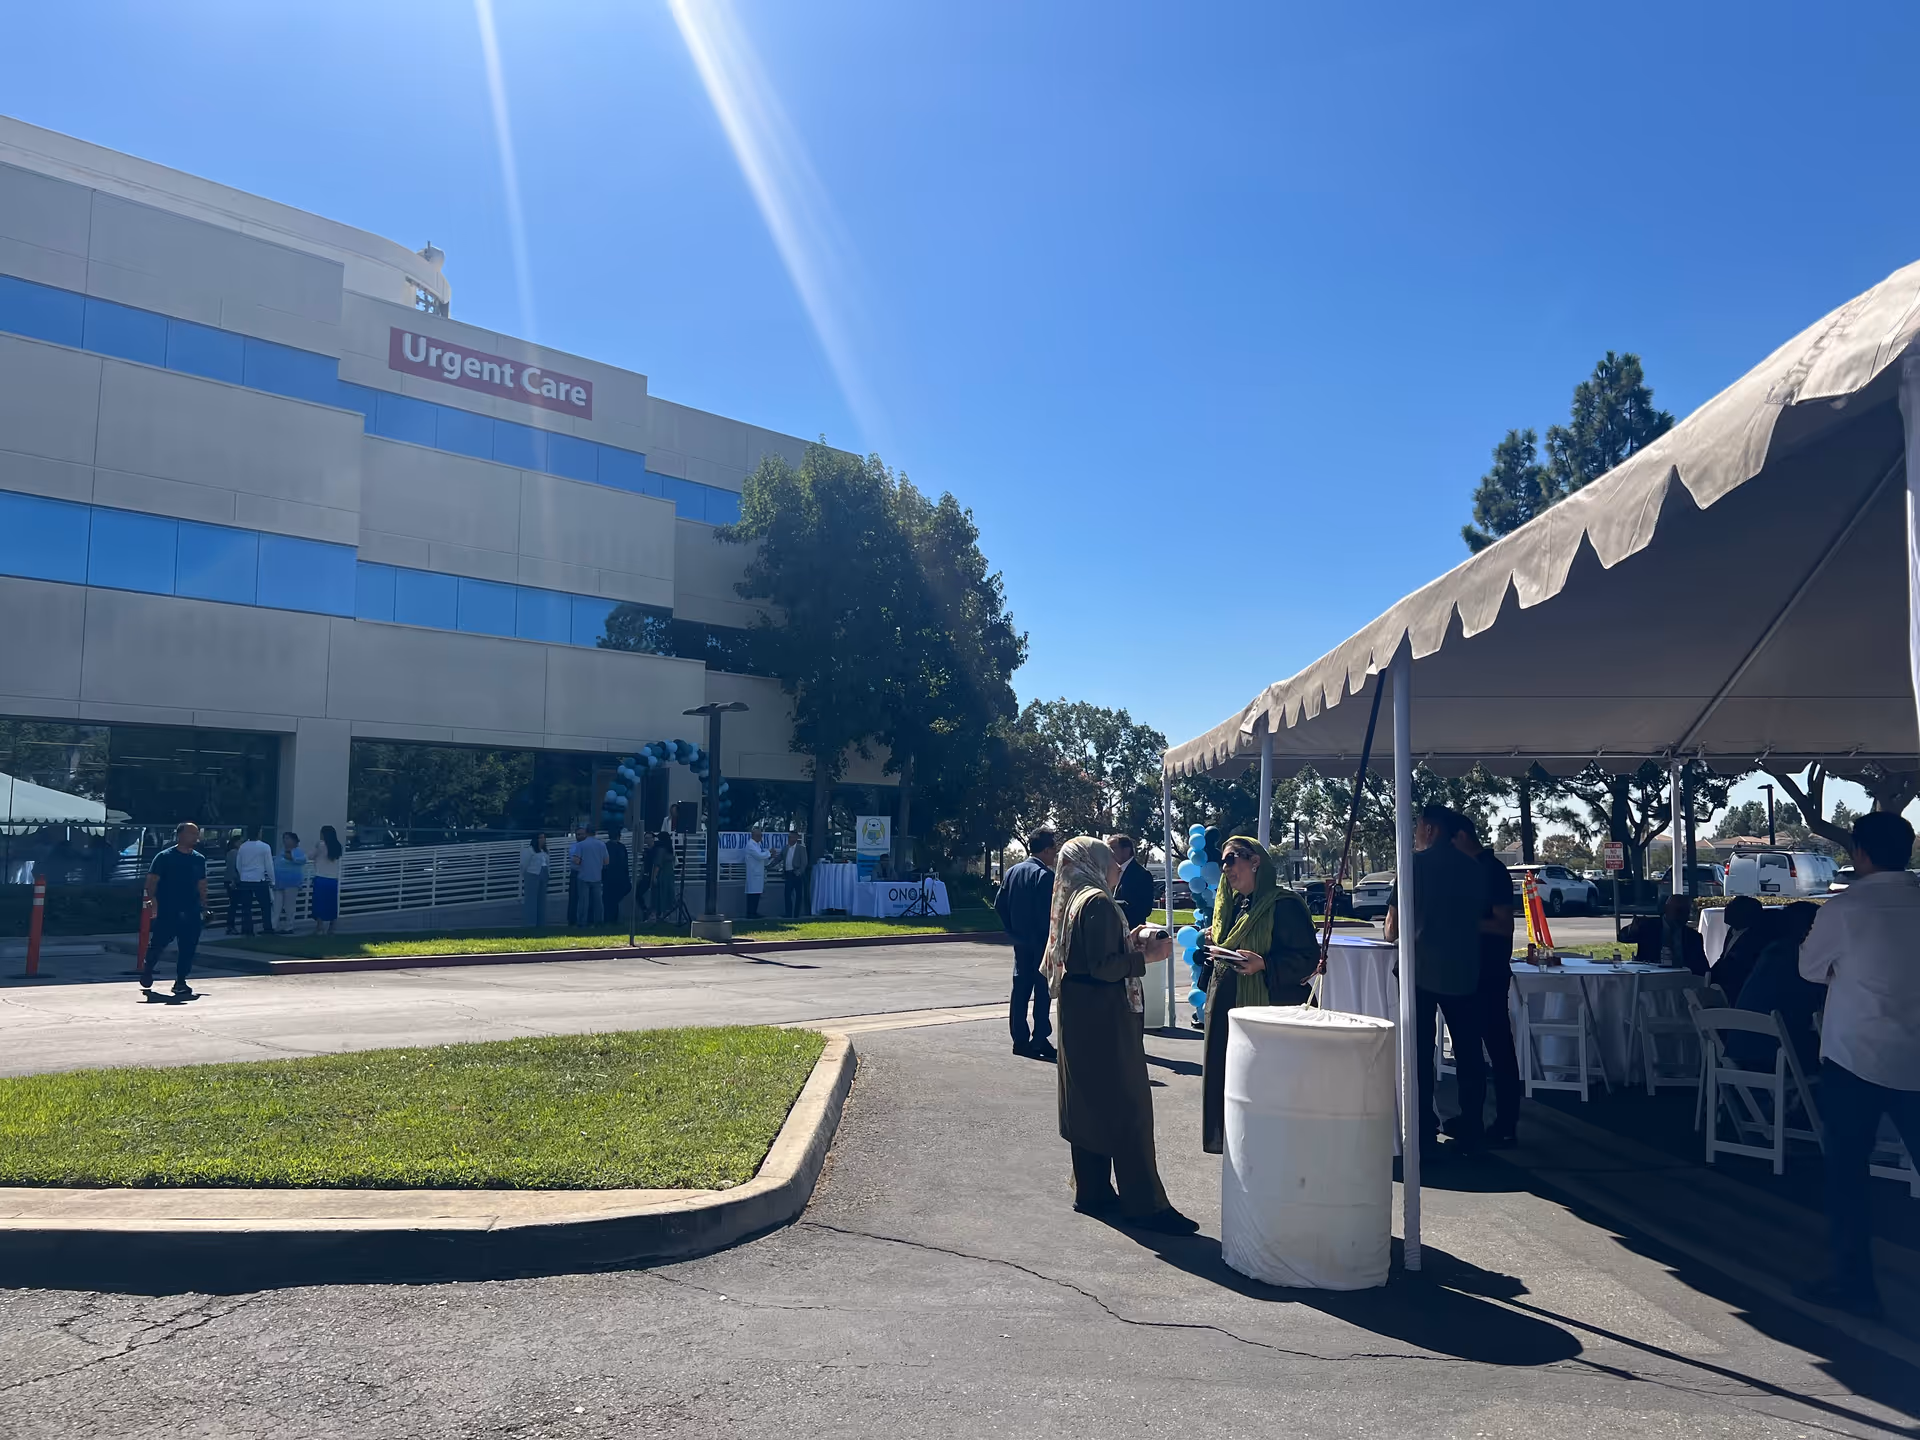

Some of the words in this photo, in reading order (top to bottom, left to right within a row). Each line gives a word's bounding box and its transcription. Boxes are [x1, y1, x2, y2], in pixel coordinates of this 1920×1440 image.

[402, 332, 515, 389] Urgent
[521, 367, 587, 407] Care
[717, 833, 737, 850] NCHO
[771, 833, 789, 850] CENT
